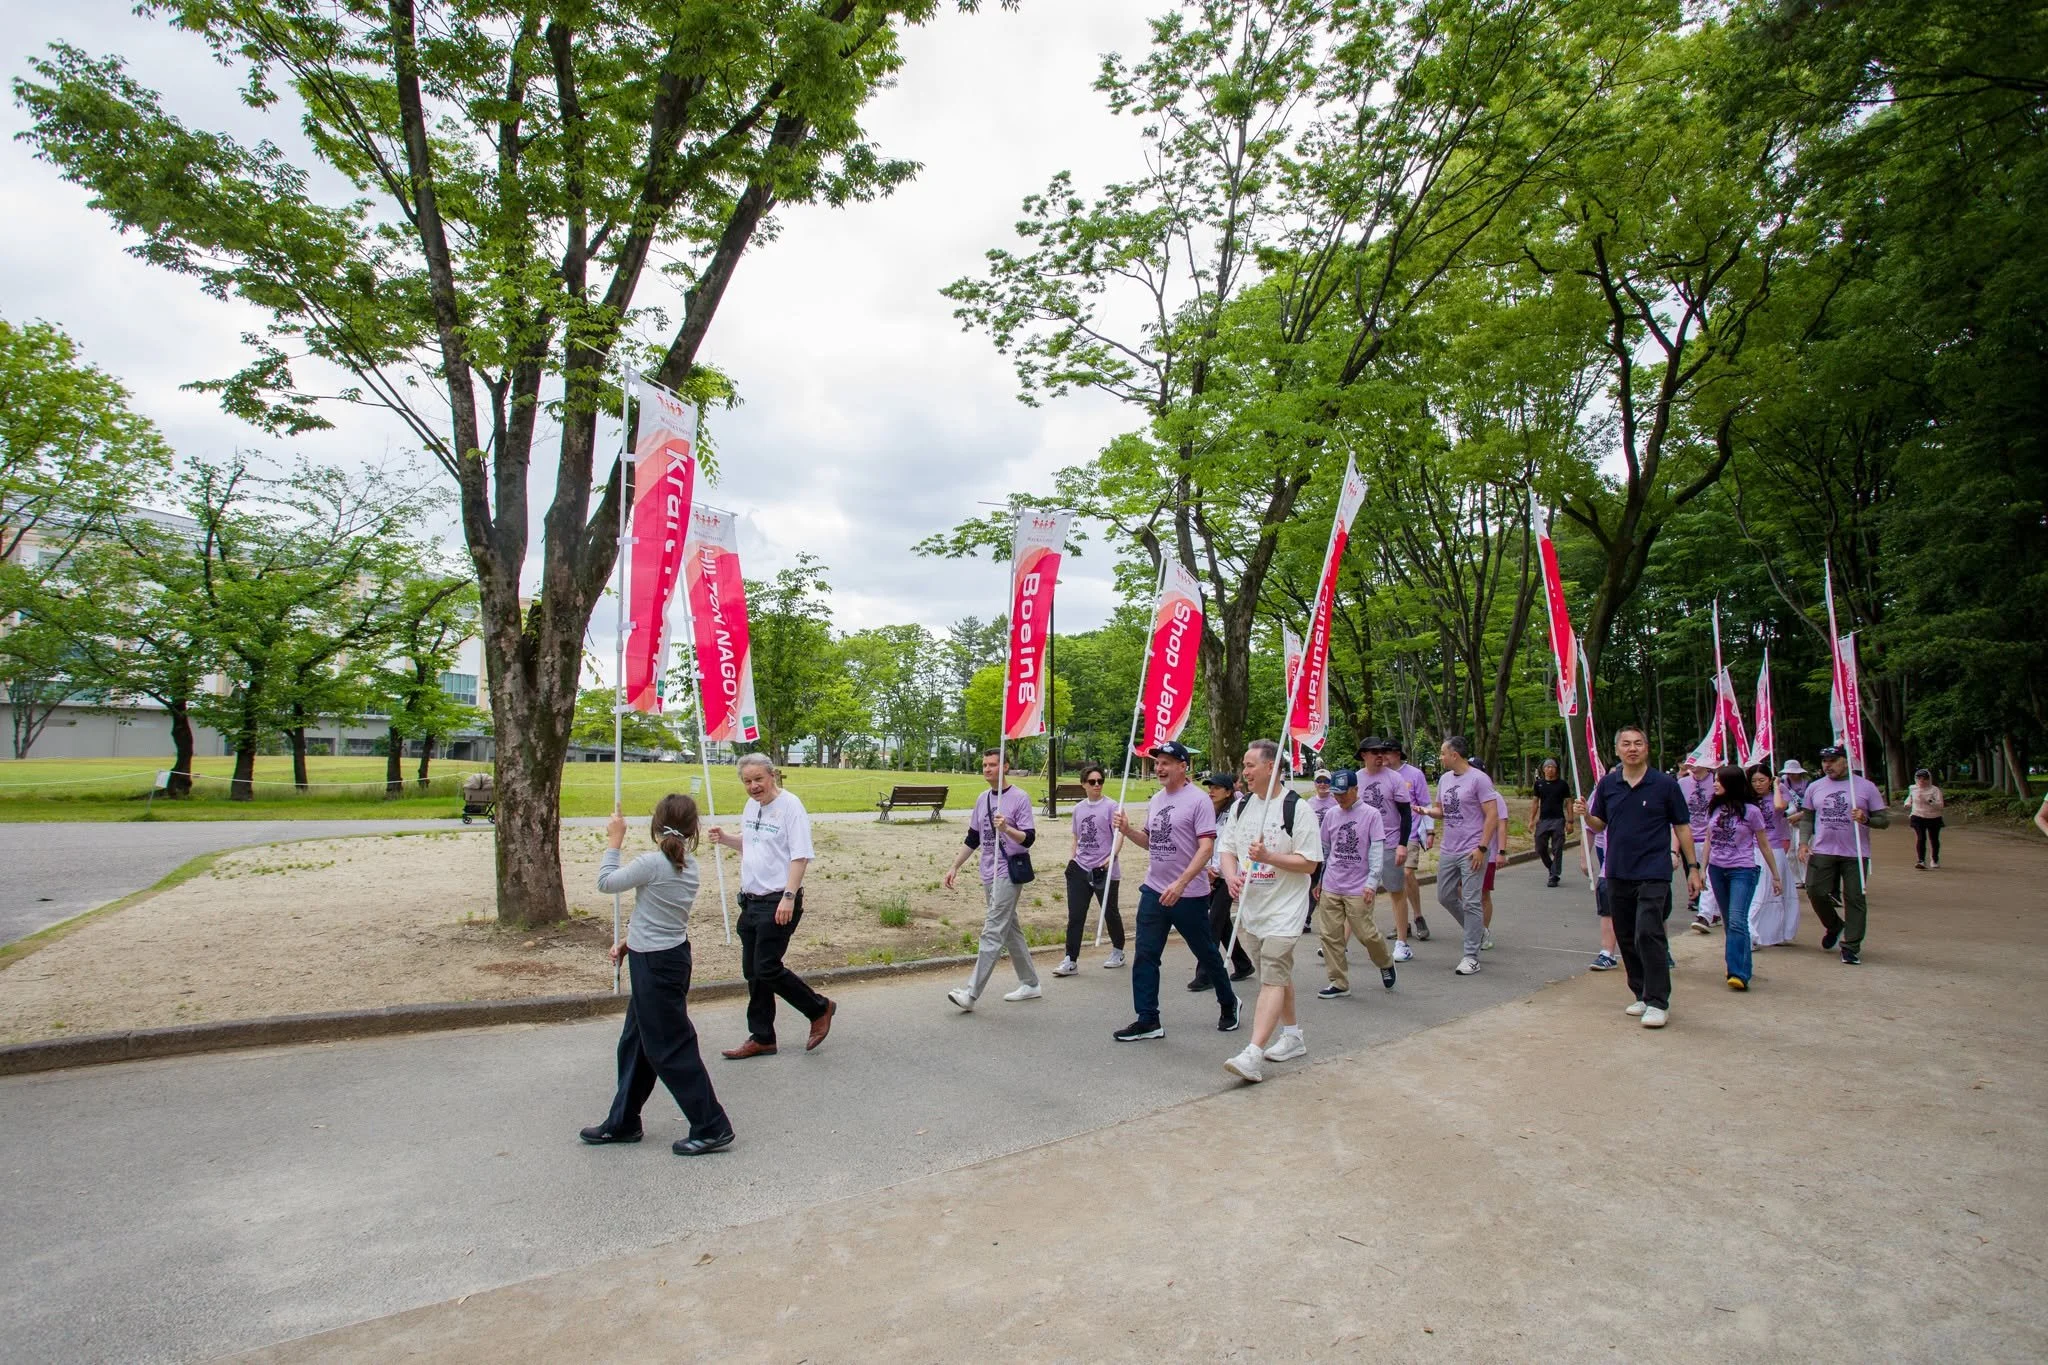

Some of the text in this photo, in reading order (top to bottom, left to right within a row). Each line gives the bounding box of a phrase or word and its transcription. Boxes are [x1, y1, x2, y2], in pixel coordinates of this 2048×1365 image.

[698, 545, 725, 625] HILTON
[715, 628, 738, 729] NAGOYA
[1018, 572, 1041, 704] Boeing
[1165, 601, 1191, 667] Shop
